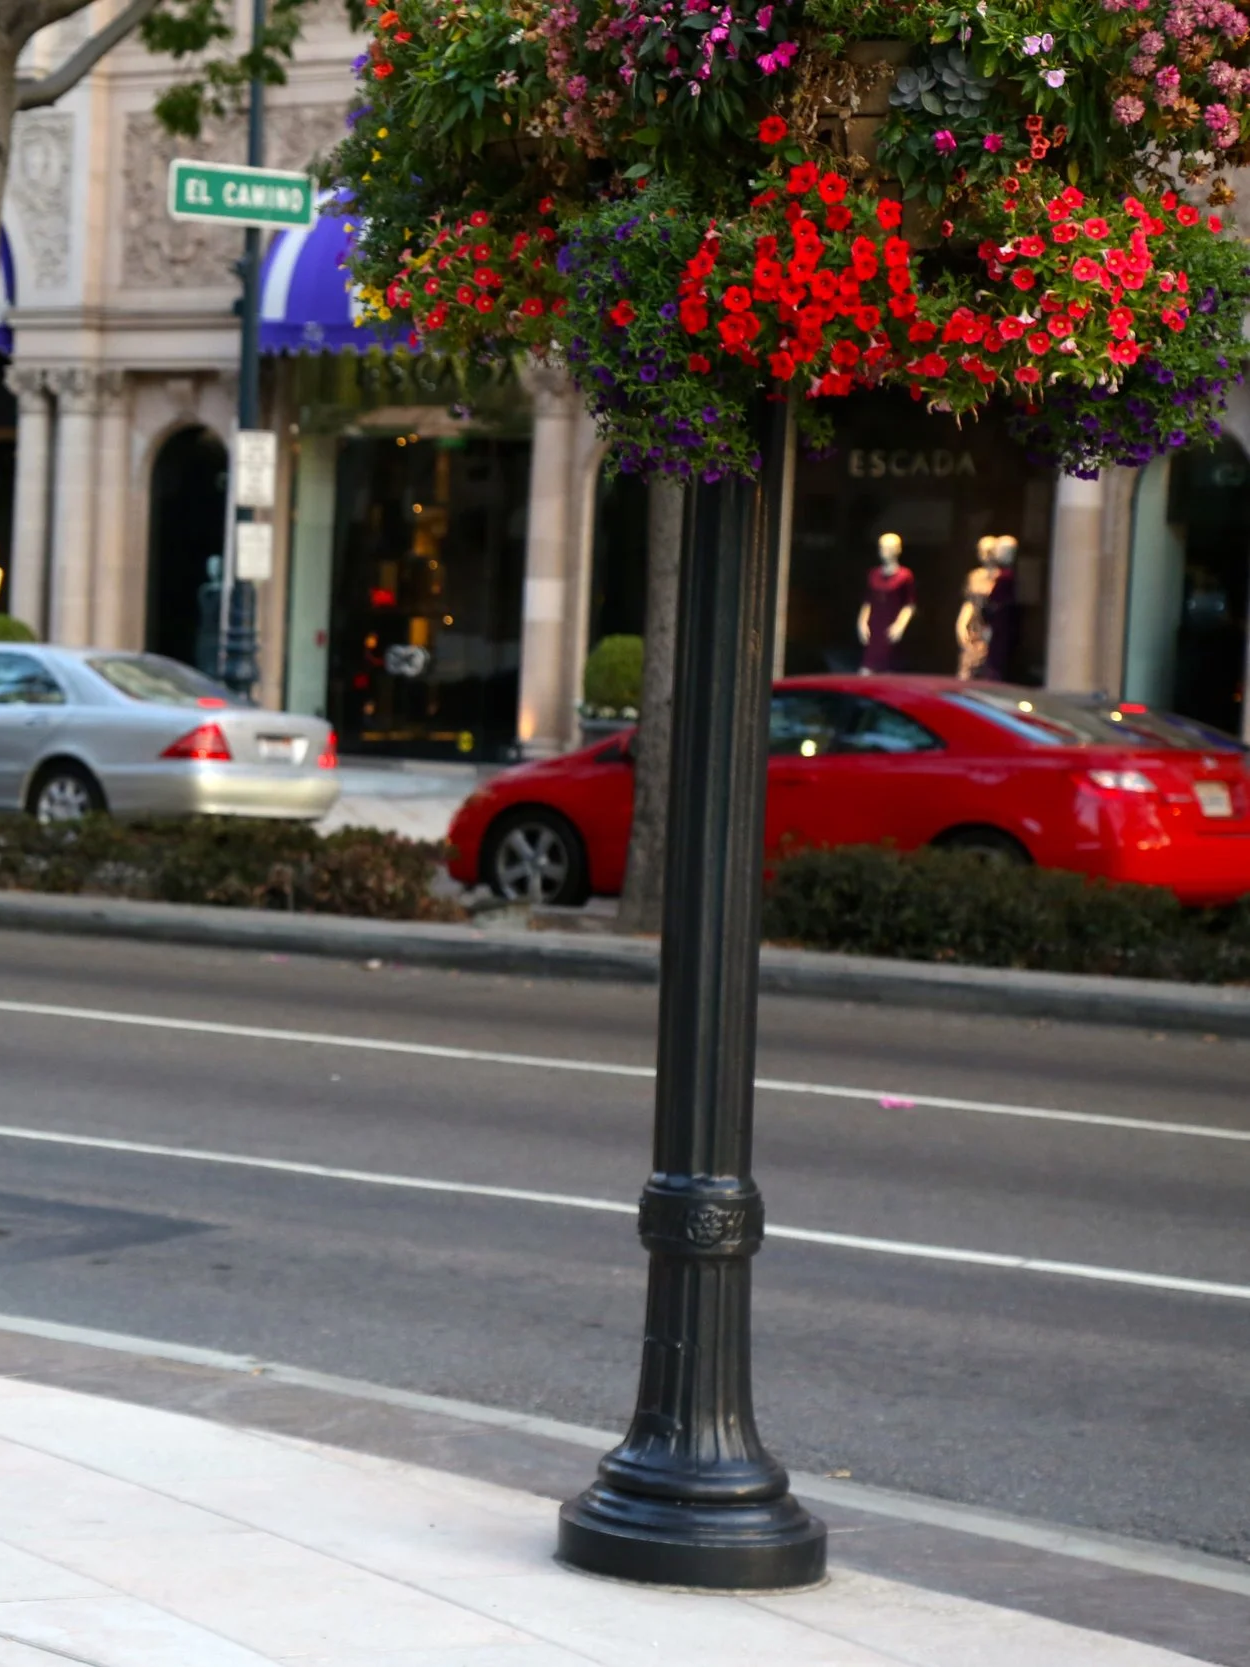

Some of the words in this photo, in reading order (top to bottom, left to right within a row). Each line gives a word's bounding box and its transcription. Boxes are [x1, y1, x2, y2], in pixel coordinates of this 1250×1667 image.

[183, 176, 214, 206] EL
[221, 180, 305, 214] CAMINO
[848, 448, 977, 478] ESCADA
